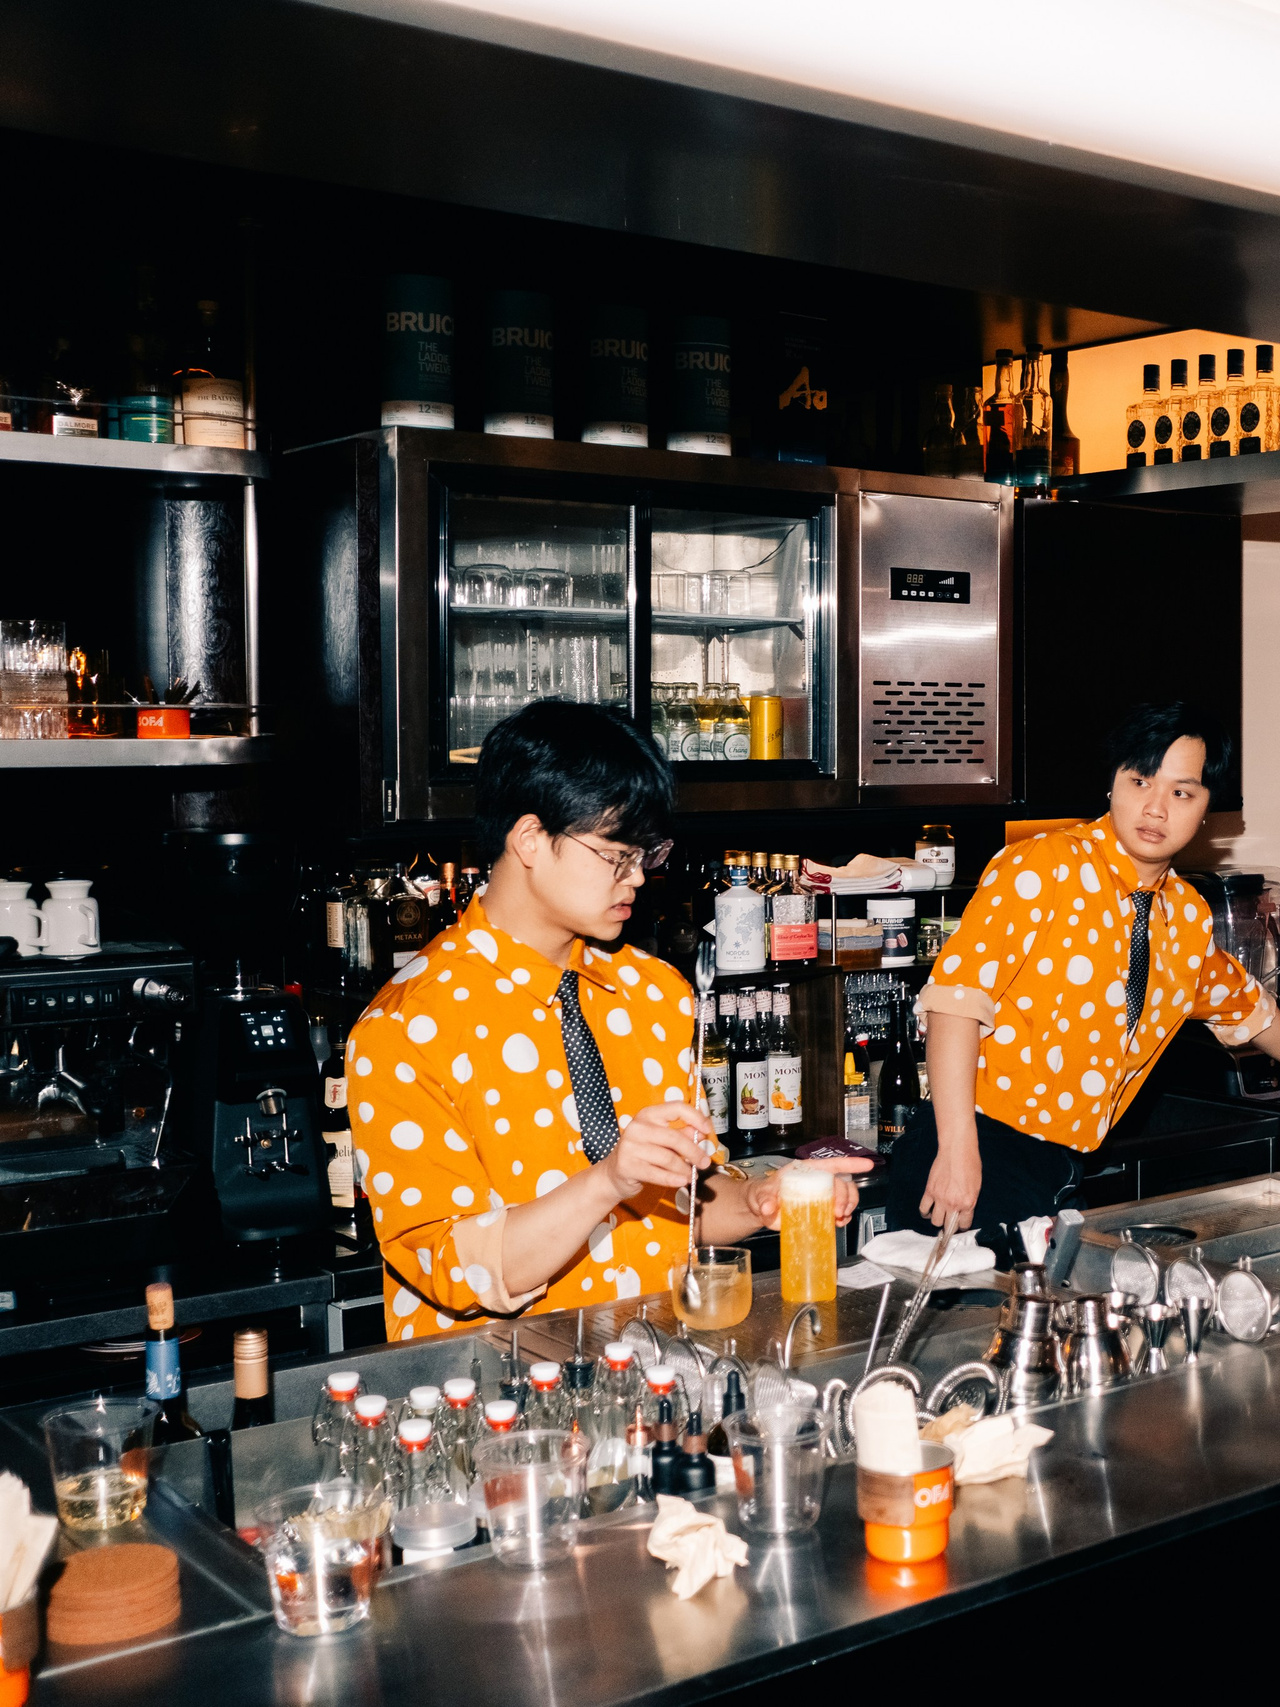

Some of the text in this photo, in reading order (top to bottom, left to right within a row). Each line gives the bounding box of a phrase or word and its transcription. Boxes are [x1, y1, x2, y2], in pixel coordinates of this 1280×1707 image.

[418, 340, 437, 352] THE
[418, 352, 449, 364] LADDIE
[419, 404, 431, 413] 12
[58, 420, 96, 430] DALMORE
[525, 416, 536, 426] 12
[621, 424, 632, 434] 12
[706, 434, 717, 443] 12
[394, 933, 423, 941] METAXA
